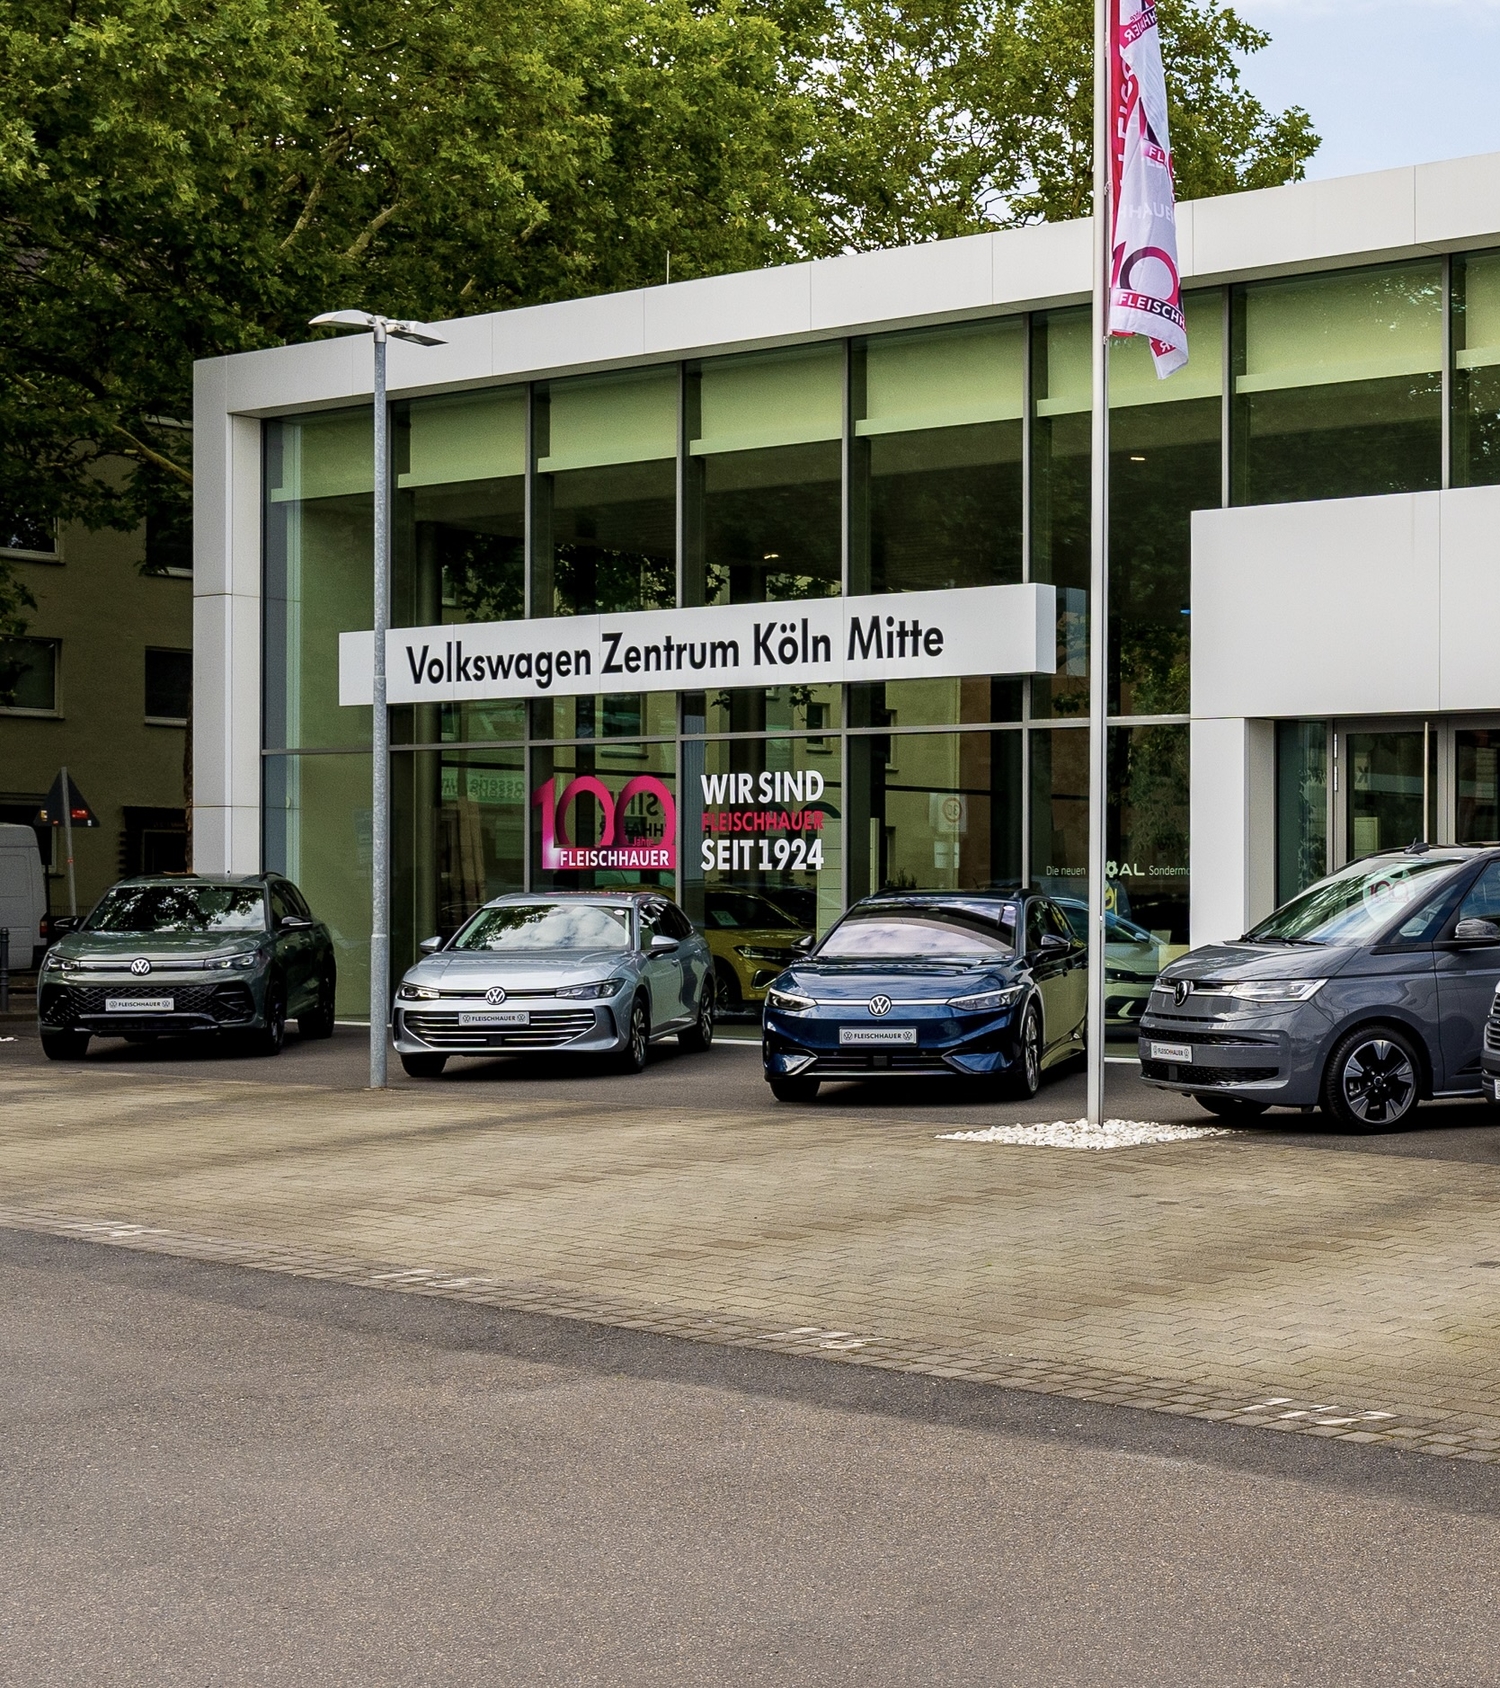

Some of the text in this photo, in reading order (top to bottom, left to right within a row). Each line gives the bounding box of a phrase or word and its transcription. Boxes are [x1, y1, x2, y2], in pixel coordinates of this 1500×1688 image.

[406, 615, 944, 689] Volkswagen Zentrum Köln Mitte
[700, 770, 824, 804] WIR SIND
[701, 810, 824, 832] FLEISCHHAUER
[560, 849, 669, 867] FLEISCHHAUER
[700, 838, 824, 871] SEIT 1924
[1046, 865, 1060, 876] Die
[1061, 867, 1086, 876] neuen
[471, 1014, 516, 1022] FLEISCHHAUER
[853, 1032, 902, 1040] FLEISCHHAUER
[1157, 1047, 1184, 1057] FLEISCHHAUER
